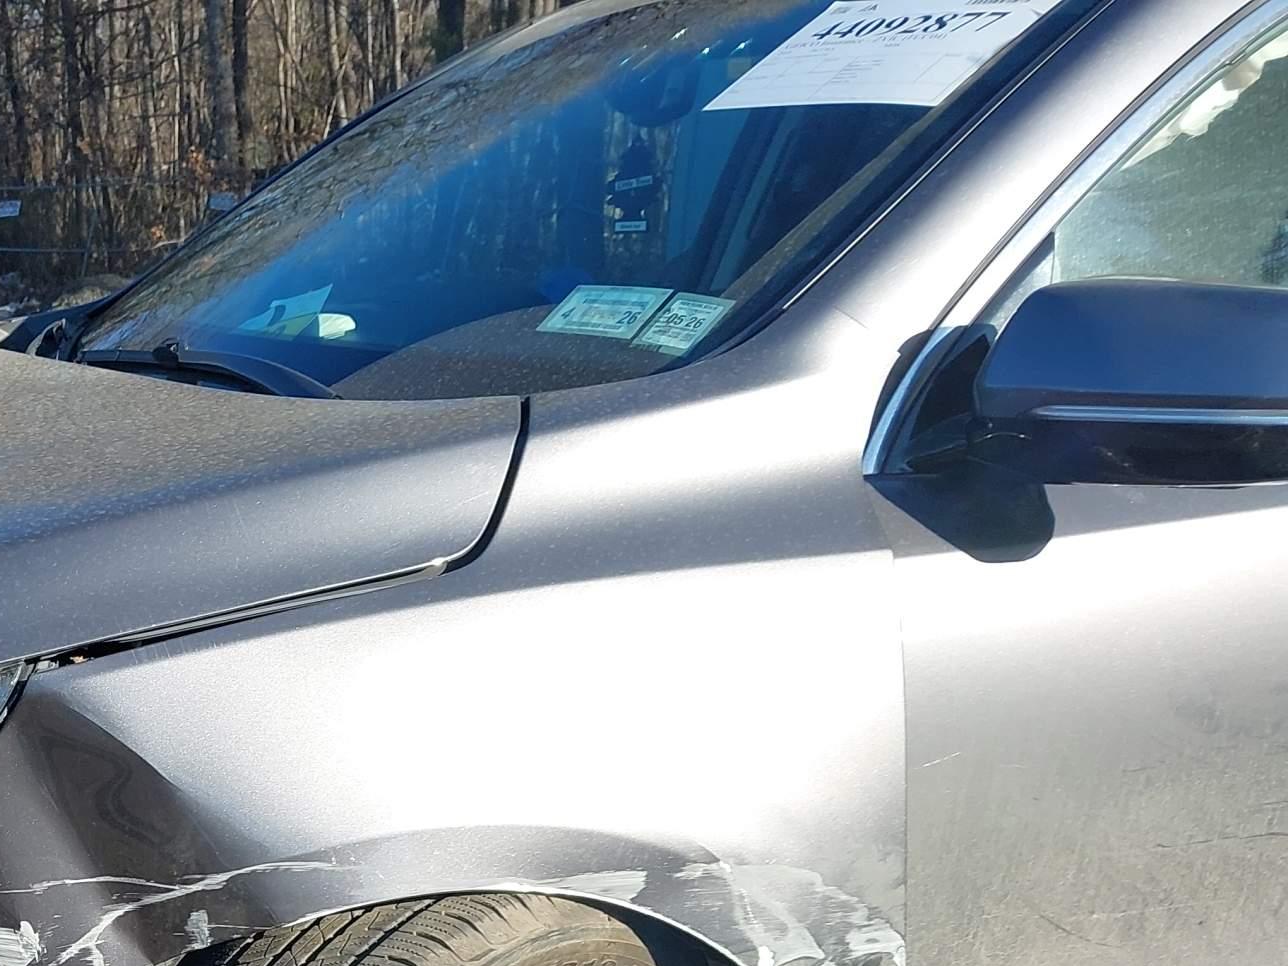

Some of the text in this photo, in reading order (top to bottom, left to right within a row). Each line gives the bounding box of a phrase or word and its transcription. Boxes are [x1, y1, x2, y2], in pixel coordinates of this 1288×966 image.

[811, 11, 1012, 40] 44092877
[616, 310, 642, 325] 26
[685, 316, 706, 329] 26
